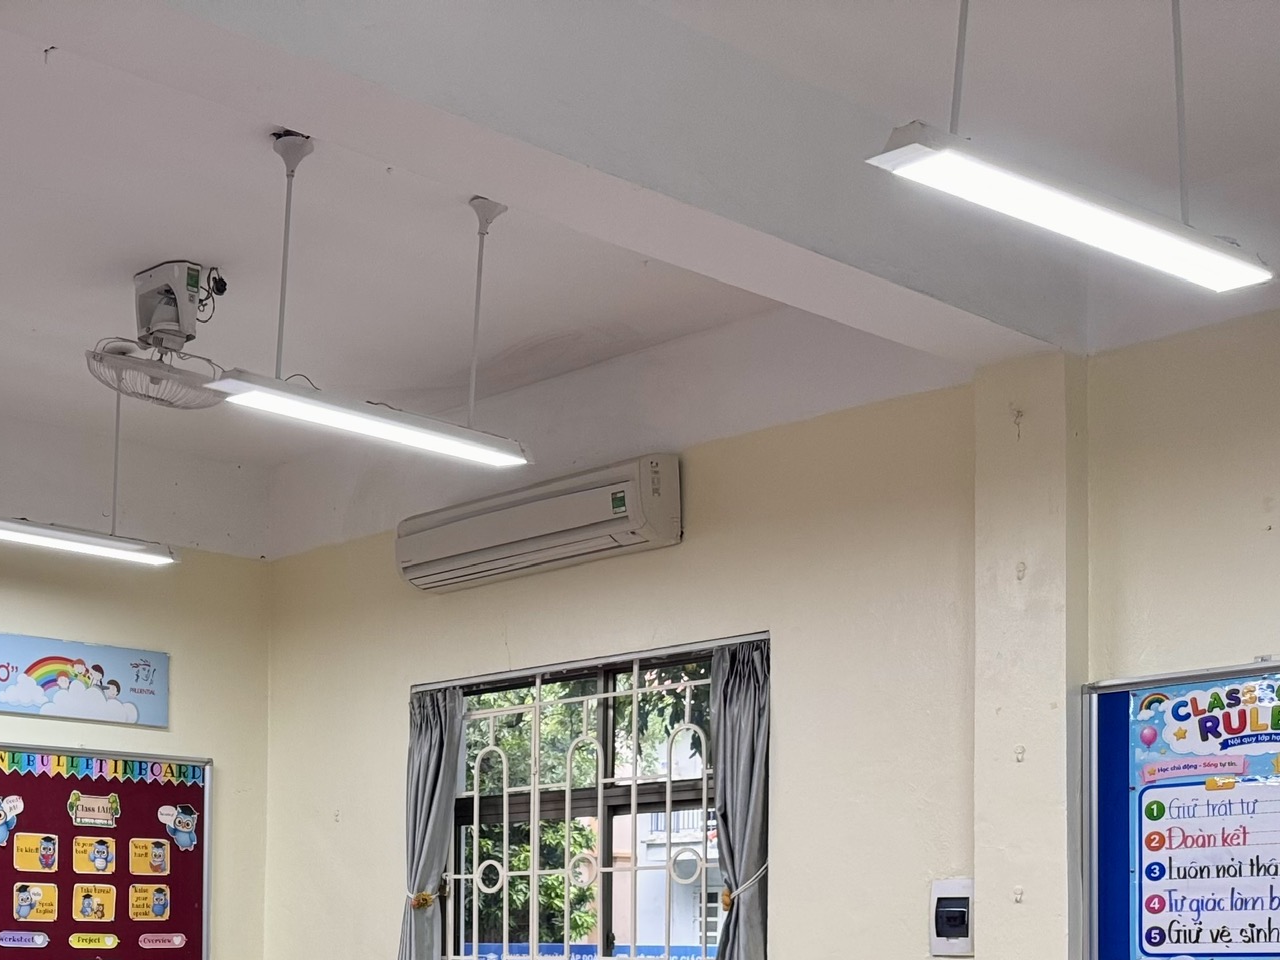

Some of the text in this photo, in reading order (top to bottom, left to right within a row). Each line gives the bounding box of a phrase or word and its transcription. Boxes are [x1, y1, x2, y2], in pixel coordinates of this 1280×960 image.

[137, 760, 202, 780] BOARD
[1157, 764, 1169, 773] Học
[76, 804, 96, 812] Class
[1151, 803, 1159, 817] 1
[1168, 797, 1198, 819] Giữ
[1150, 824, 1249, 850] 2 Đoàn kết
[1150, 865, 1160, 877] 3
[1168, 855, 1210, 880] Luôn
[1249, 855, 1280, 880] thậ
[1150, 897, 1160, 911] 4
[1229, 886, 1265, 913] làm
[77, 936, 101, 945] Project
[1150, 917, 1280, 949] 5 Giữ vệ sinh
